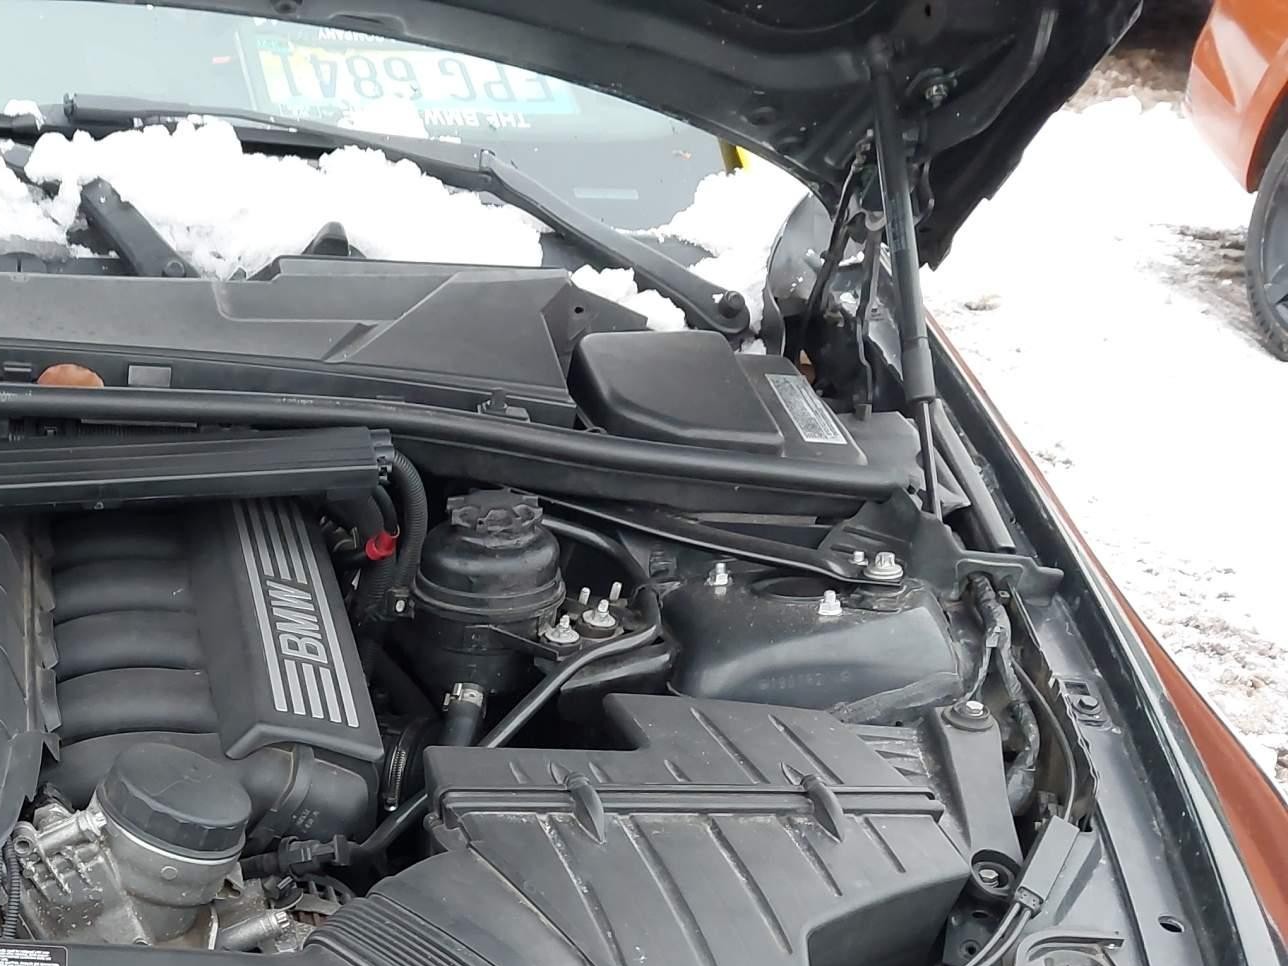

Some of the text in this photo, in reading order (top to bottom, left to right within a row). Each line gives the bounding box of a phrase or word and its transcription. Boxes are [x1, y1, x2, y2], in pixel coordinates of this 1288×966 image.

[271, 51, 423, 101] 6841
[423, 110, 531, 128] THE BMW
[266, 580, 328, 664] BMW
